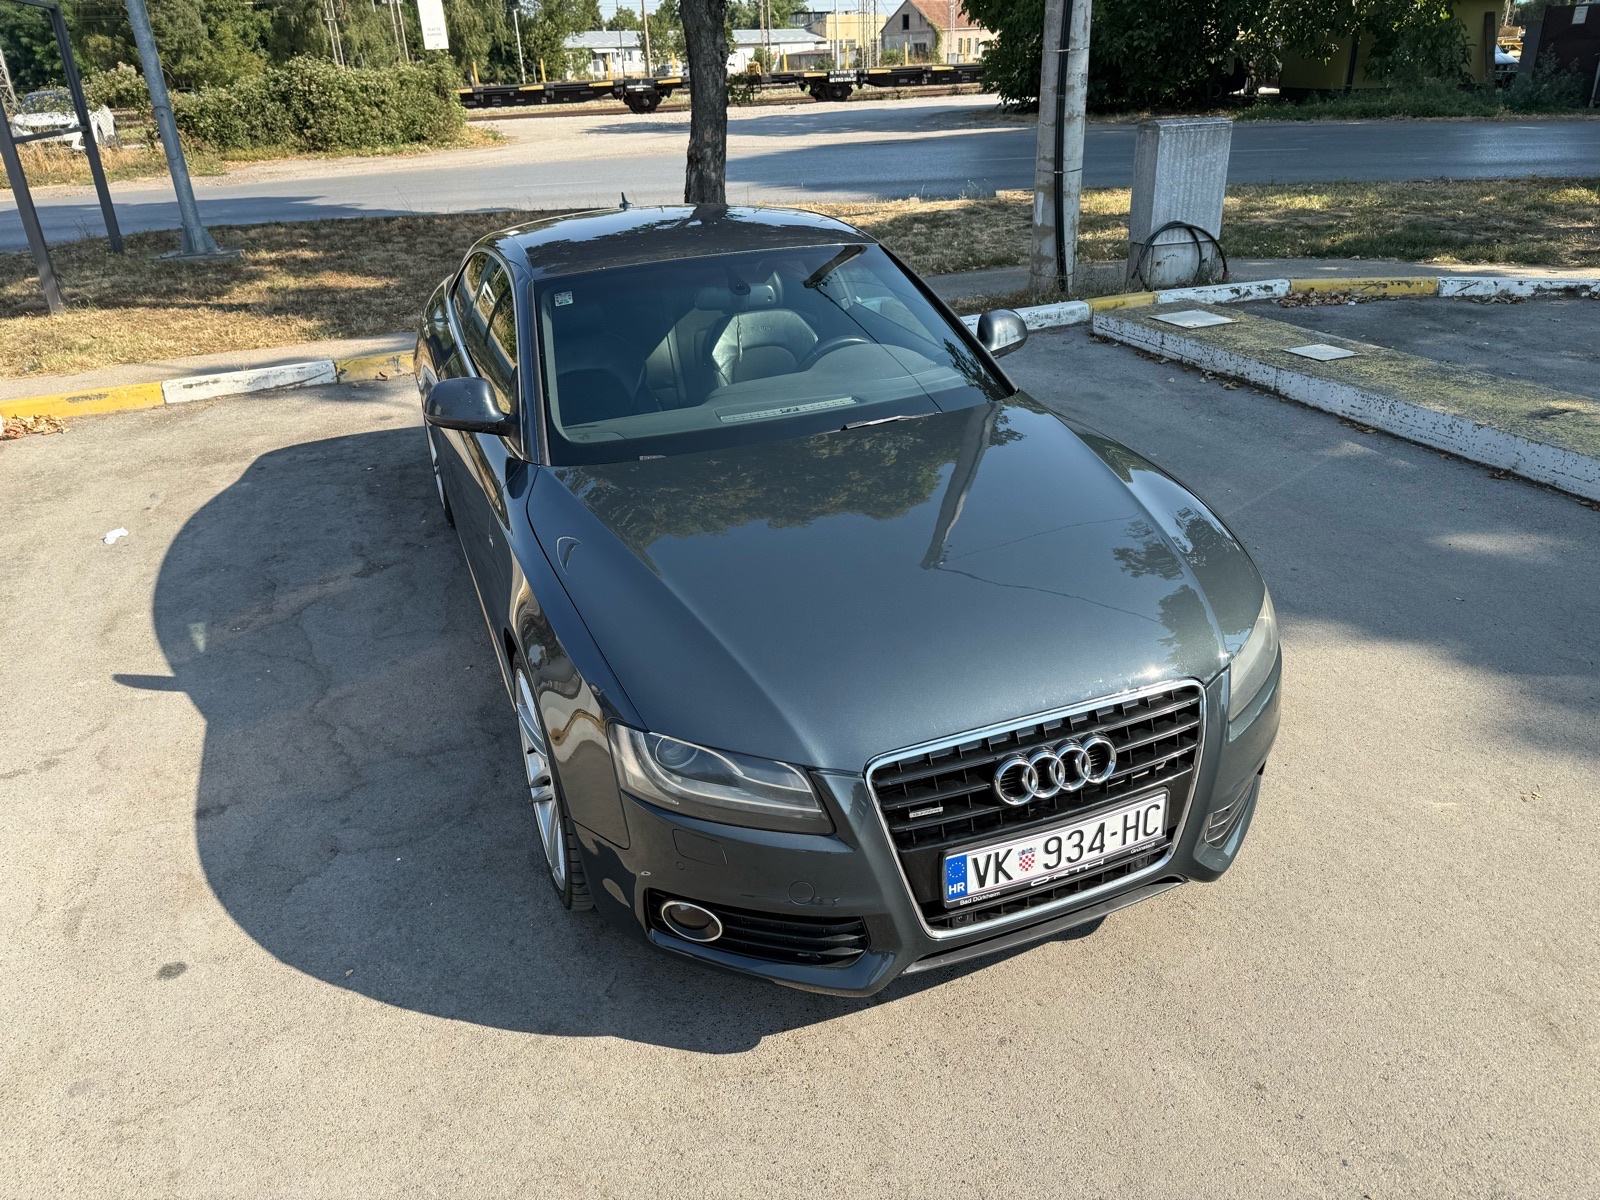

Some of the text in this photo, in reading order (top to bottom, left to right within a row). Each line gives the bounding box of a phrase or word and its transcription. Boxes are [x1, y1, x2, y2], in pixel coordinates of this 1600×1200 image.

[971, 803, 1161, 889] VK 934-HC
[948, 881, 966, 895] HR
[960, 897, 972, 906] Bad
